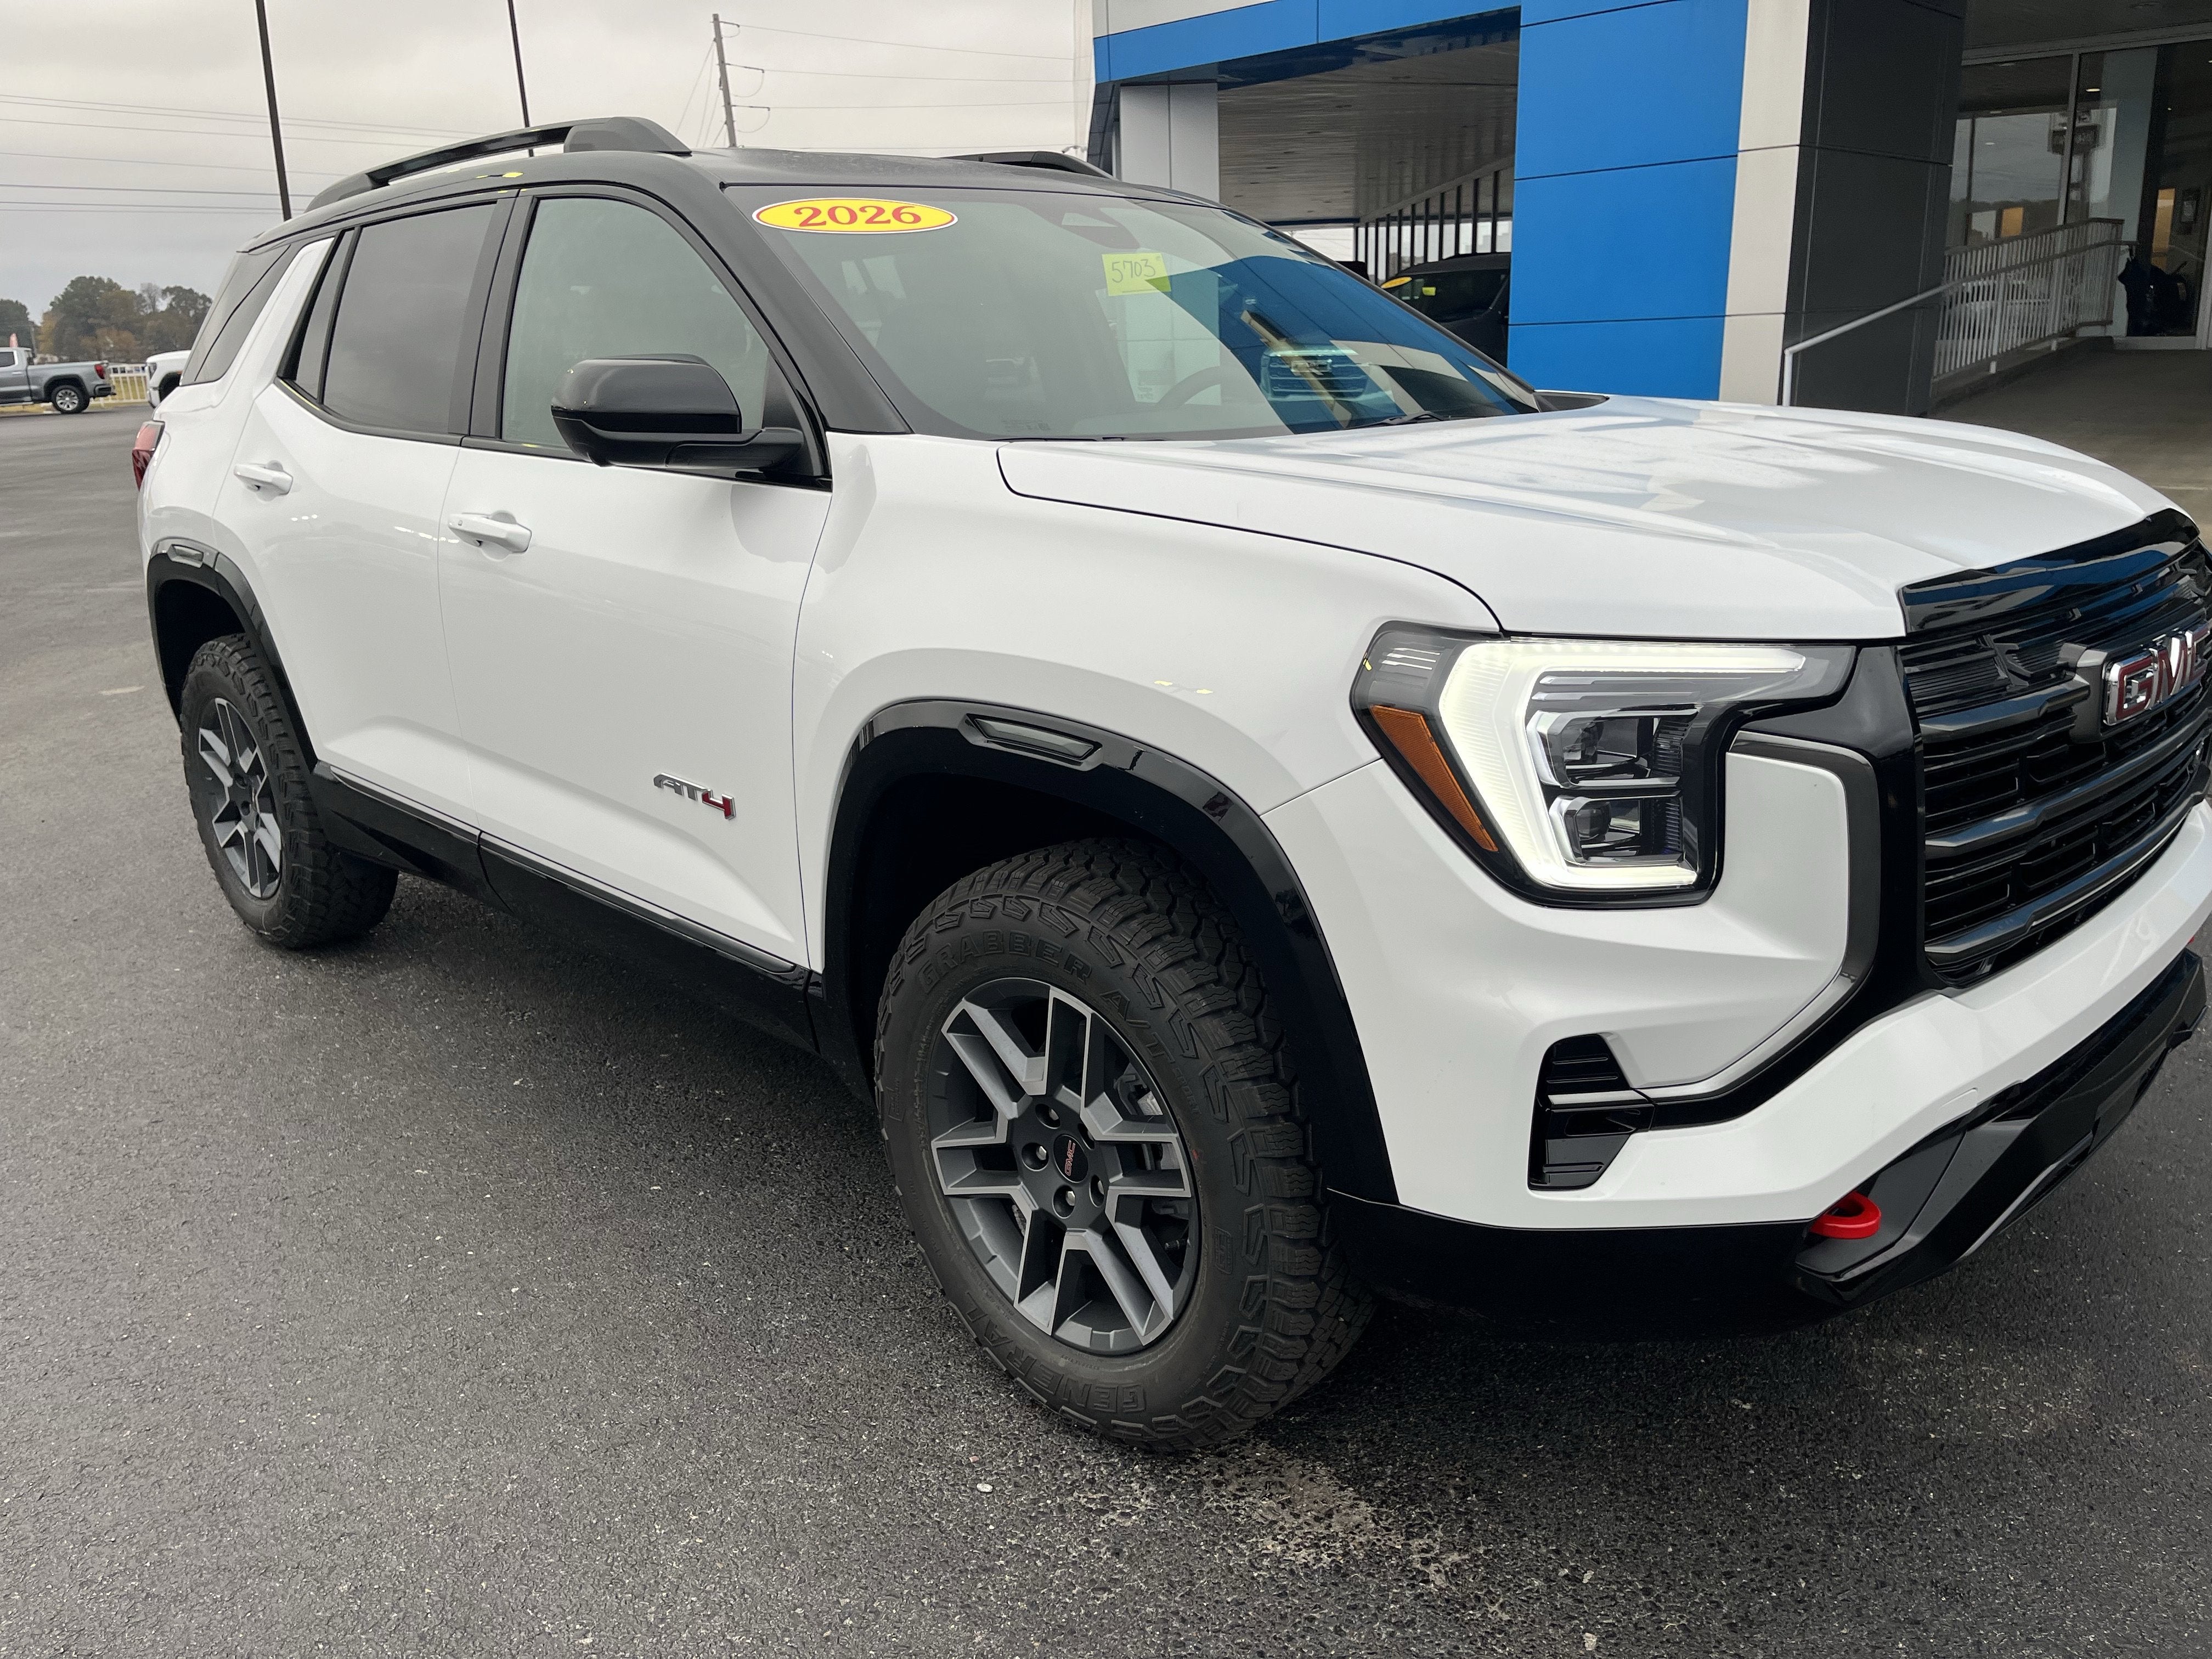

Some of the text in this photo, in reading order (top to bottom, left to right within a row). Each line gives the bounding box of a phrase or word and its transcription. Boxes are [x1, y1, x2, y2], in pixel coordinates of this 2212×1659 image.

[793, 205, 922, 227] 2026
[1111, 258, 1156, 283] 5703
[2102, 623, 2211, 726] GMC
[653, 772, 736, 820] AT4
[917, 928, 1092, 995] GRABBER
[1064, 1139, 1076, 1177] GMC
[965, 1291, 1147, 1413] GENERAL
